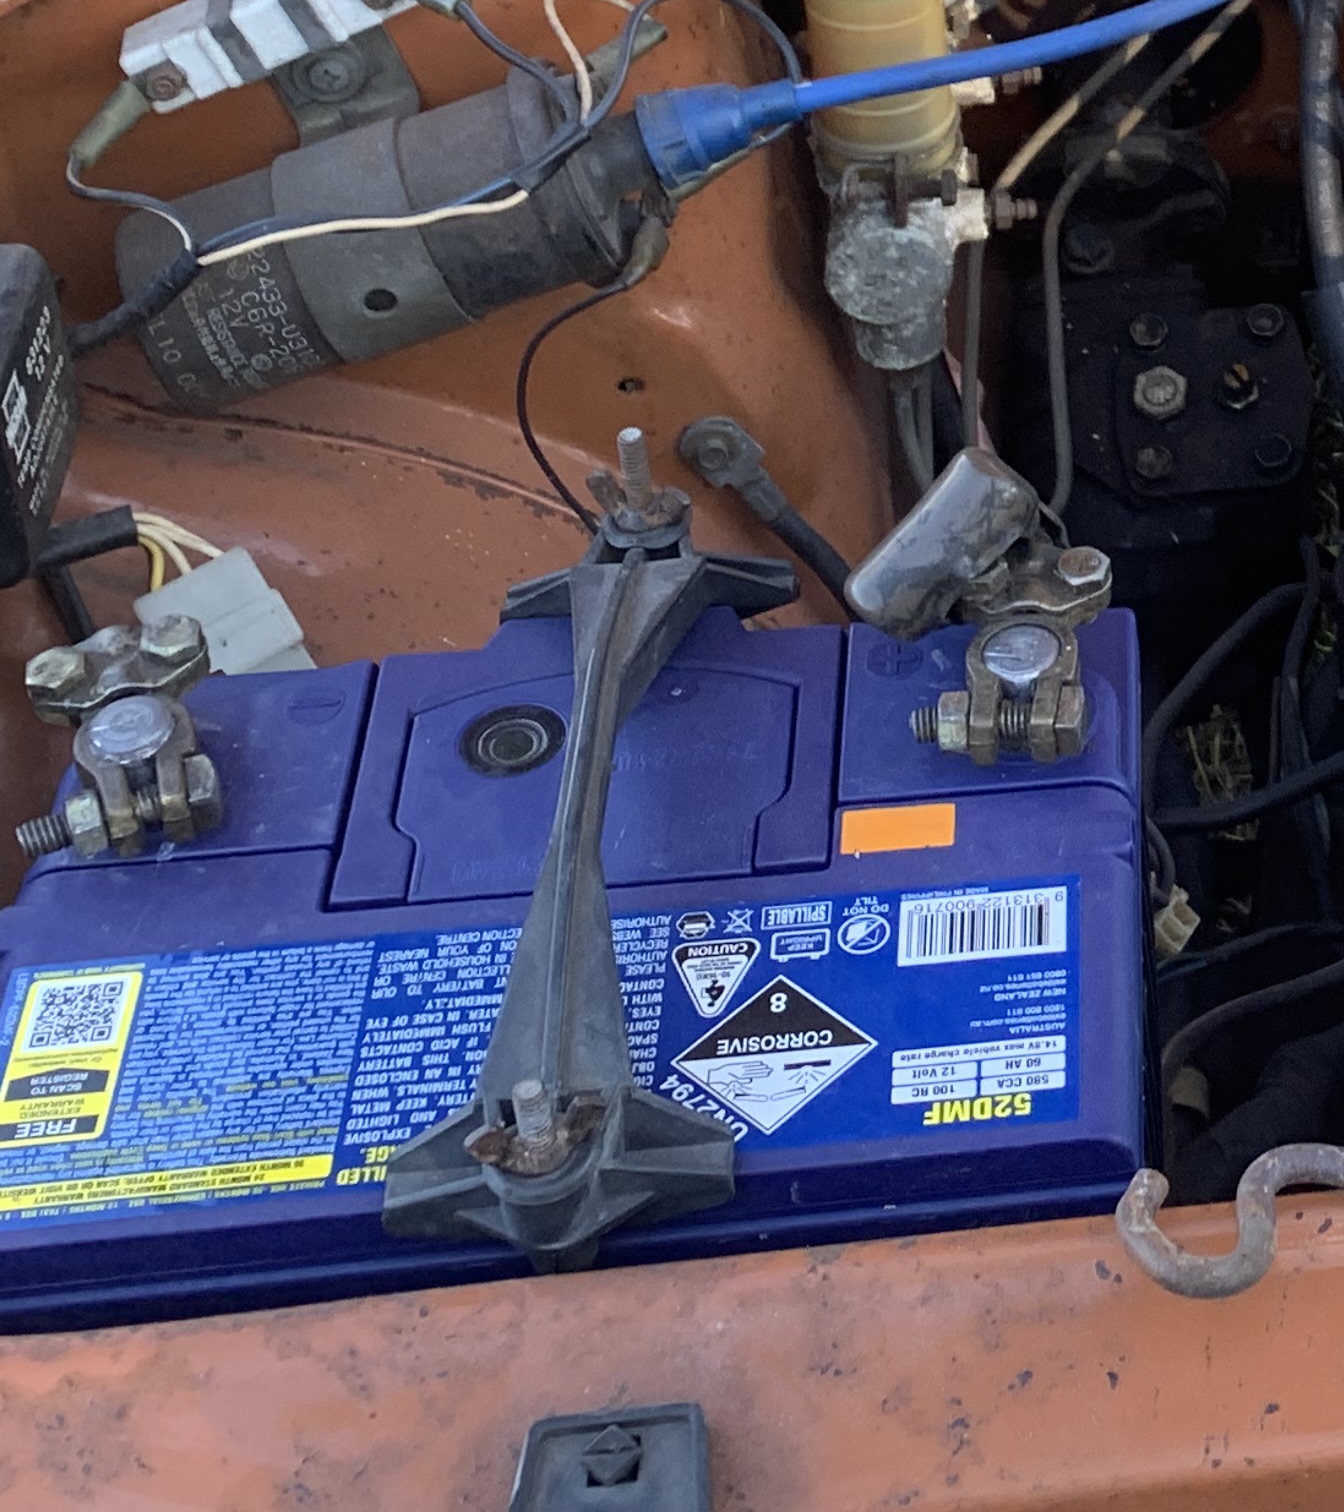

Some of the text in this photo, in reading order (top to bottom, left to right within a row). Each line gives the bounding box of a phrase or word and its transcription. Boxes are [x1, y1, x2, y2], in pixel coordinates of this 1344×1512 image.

[854, 896, 878, 905] TILT
[914, 891, 1063, 914] 9 313122 900716
[767, 904, 826, 925] SPILLABLE
[842, 903, 889, 916] DO NOT
[648, 927, 671, 938] SEE
[780, 935, 822, 945] UPRIGHT
[787, 942, 813, 951] KEEP
[437, 944, 469, 956] YOUR
[477, 942, 493, 954] OF
[687, 943, 748, 957] CAUTION
[377, 948, 429, 963] NEAREST
[422, 954, 491, 970] HOUSEHOLD
[494, 953, 507, 963] IN
[624, 962, 666, 977] PLEASE
[373, 975, 392, 987] OR
[371, 986, 397, 999] OUR
[407, 984, 423, 996] TO
[993, 988, 1066, 1001] NEW ZEALAND
[631, 992, 663, 1004] WITH
[770, 992, 787, 1013] 8
[392, 1015, 408, 1027] OF
[412, 1012, 444, 1025] CASE
[446, 1010, 461, 1022] IN
[365, 1017, 389, 1030] EYE
[451, 1021, 491, 1035] FLUSH
[1009, 1022, 1066, 1034] AUSTRALIA
[362, 1025, 446, 1044] IMMEDIATELY
[430, 1037, 460, 1051] ACID
[466, 1036, 478, 1048] IF
[716, 1029, 833, 1055] CORROSIVE
[360, 1040, 424, 1059] CONTACTS
[925, 1049, 960, 1061] charge
[963, 1045, 1000, 1055] vehicle
[356, 1056, 412, 1072] BATTERY
[422, 1052, 450, 1066] THIS
[900, 1053, 921, 1062] rate
[1005, 1058, 1041, 1069] 60 AH
[424, 1068, 442, 1079] AN
[447, 1065, 462, 1077] IN
[912, 1066, 955, 1079] 12 Volt
[30, 1072, 88, 1085] REGISTER
[354, 1070, 419, 1087] ENCLOSED
[997, 1075, 1049, 1089] 580 CCA
[30, 1082, 82, 1096] SCAN TO
[351, 1086, 389, 1101] WHEN
[393, 1080, 466, 1097] TERMINALS.
[912, 1085, 955, 1097] 100 RC
[20, 1098, 85, 1110] WARRANTY
[350, 1101, 392, 1115] METAL
[396, 1096, 428, 1110] KEEP
[923, 1093, 1031, 1125] 52DMF
[19, 1107, 80, 1119] EXTENDED
[346, 1110, 437, 1130] AND LIGHTED
[14, 1118, 77, 1139] FREE
[343, 1127, 411, 1145] EXPLOSIVE
